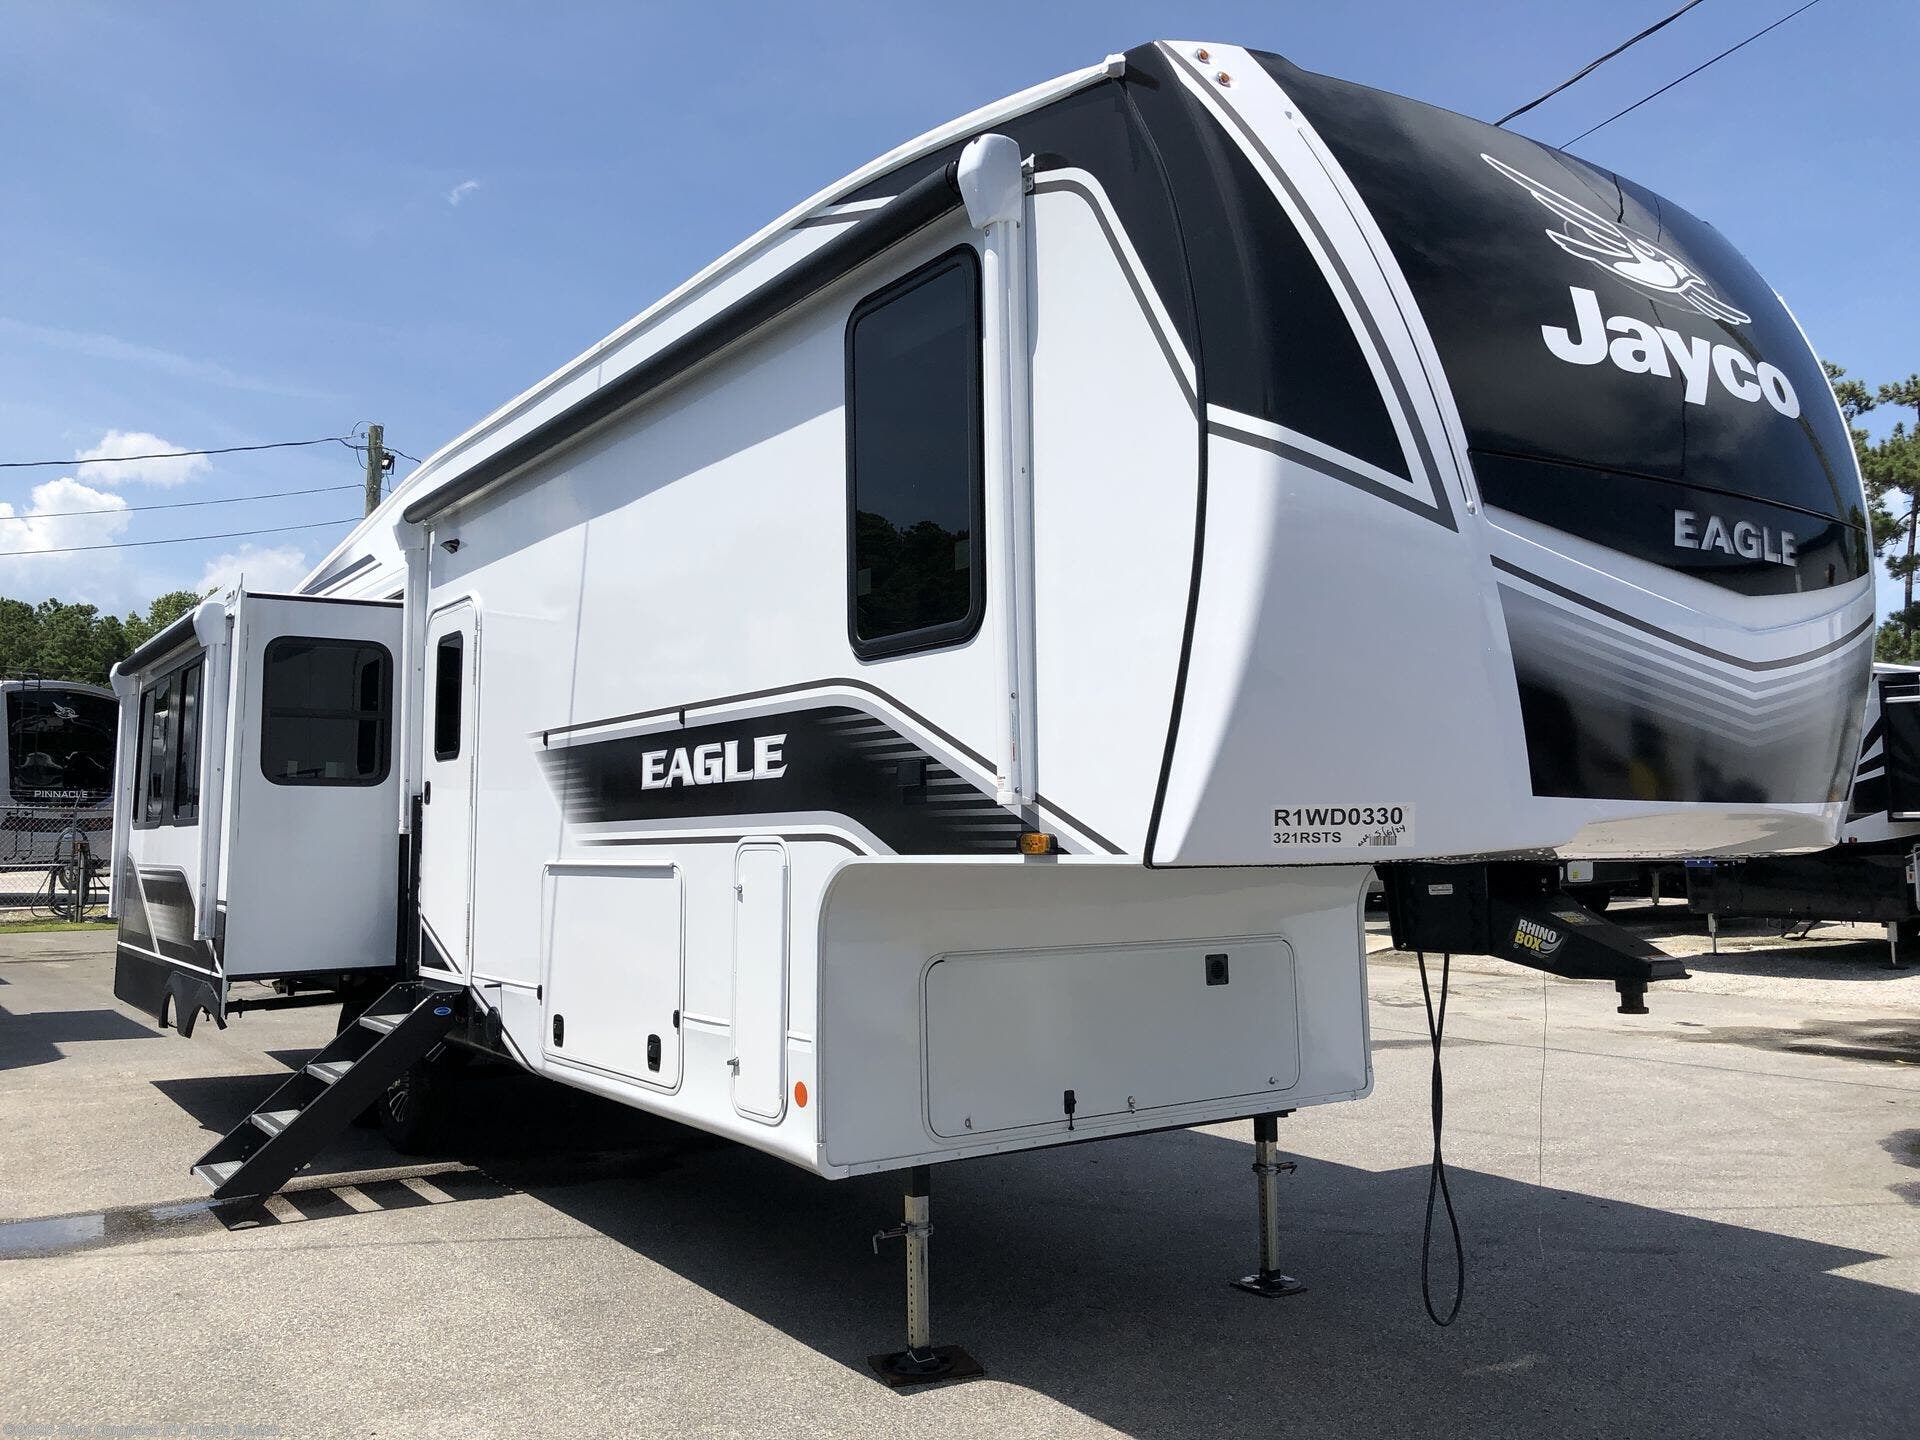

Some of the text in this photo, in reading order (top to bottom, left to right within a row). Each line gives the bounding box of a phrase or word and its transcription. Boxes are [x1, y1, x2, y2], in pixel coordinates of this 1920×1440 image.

[1541, 286, 1800, 419] Jayco
[1674, 508, 1797, 567] EAGLE
[641, 733, 788, 790] EAGLE
[34, 790, 88, 799] PINNACLE
[1274, 807, 1403, 827] R1WD0330
[1273, 831, 1342, 844] 321RSTS
[1514, 930, 1542, 952] BOX
[1517, 918, 1557, 943] RHINO
